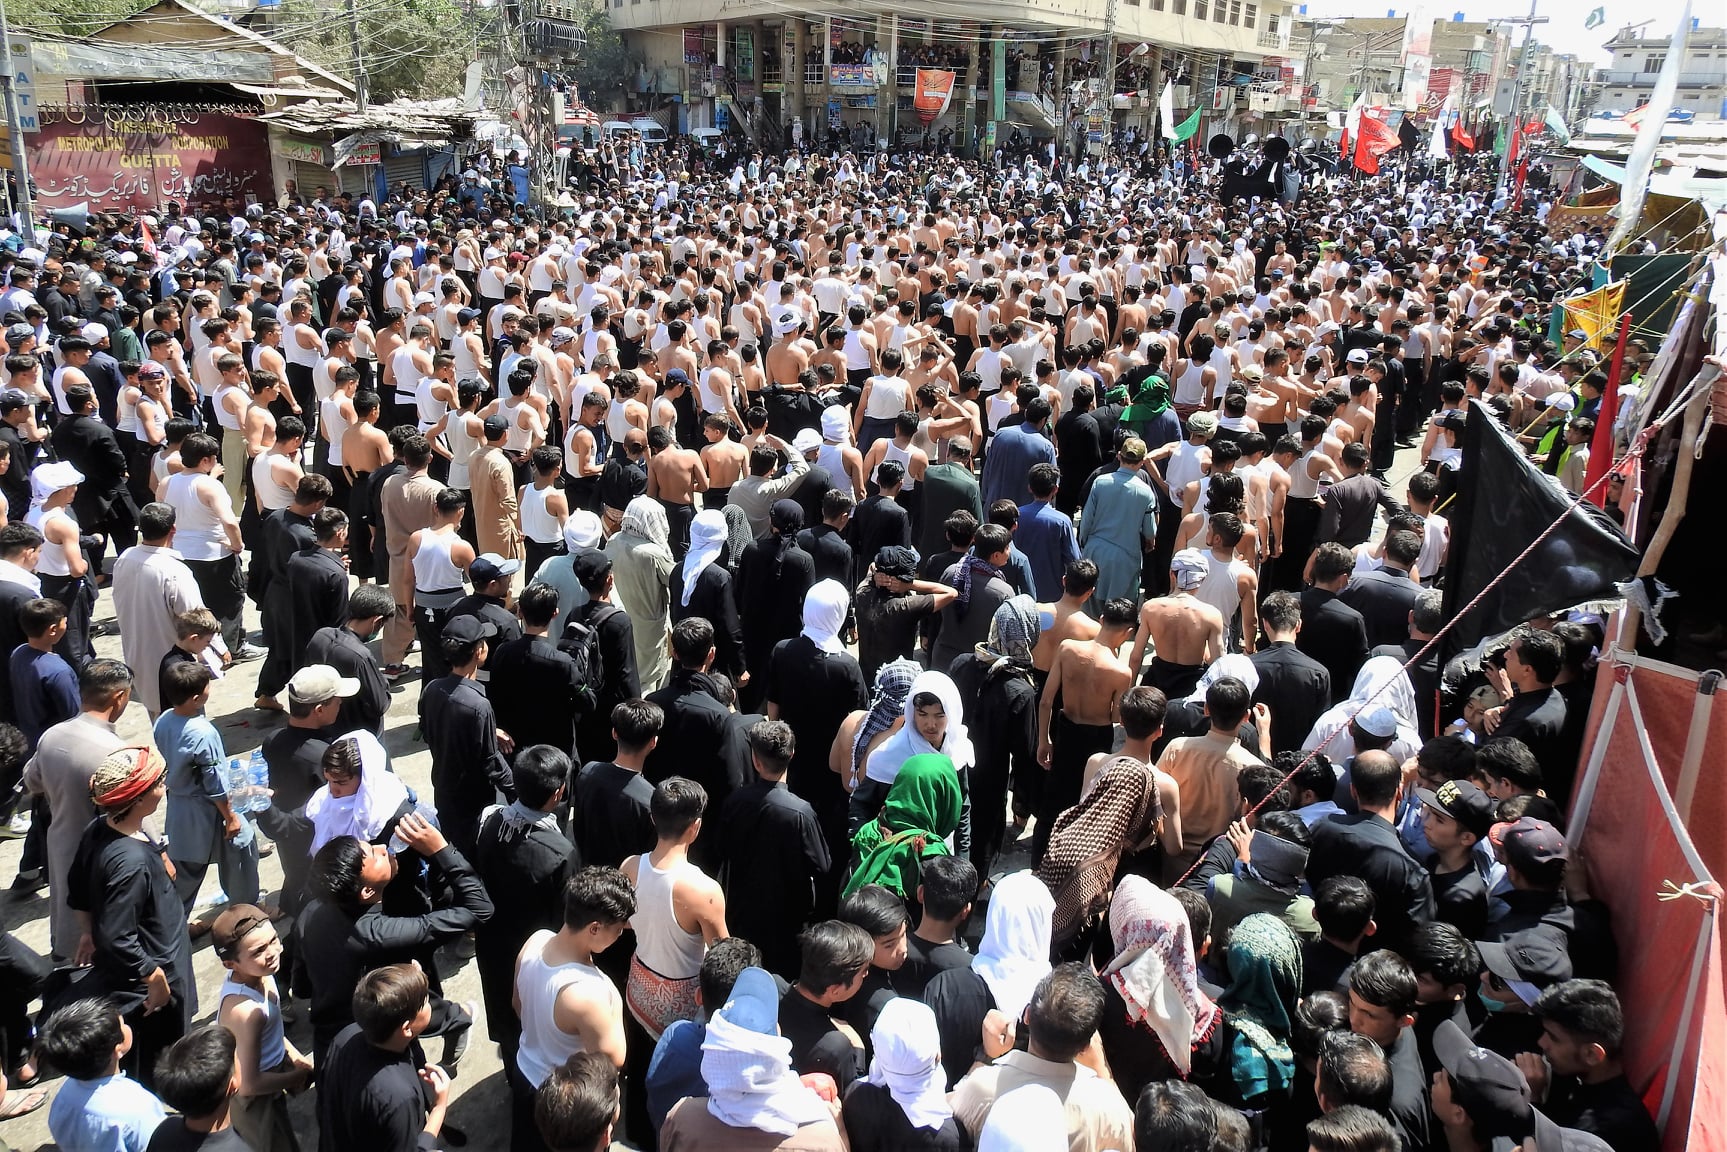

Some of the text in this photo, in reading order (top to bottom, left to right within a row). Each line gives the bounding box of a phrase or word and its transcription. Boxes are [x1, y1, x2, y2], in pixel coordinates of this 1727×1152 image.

[16, 72, 35, 127] ATM
[57, 136, 125, 151] METROPOLITAN
[171, 136, 229, 150] CORPORATION
[120, 154, 182, 168] QUETTA
